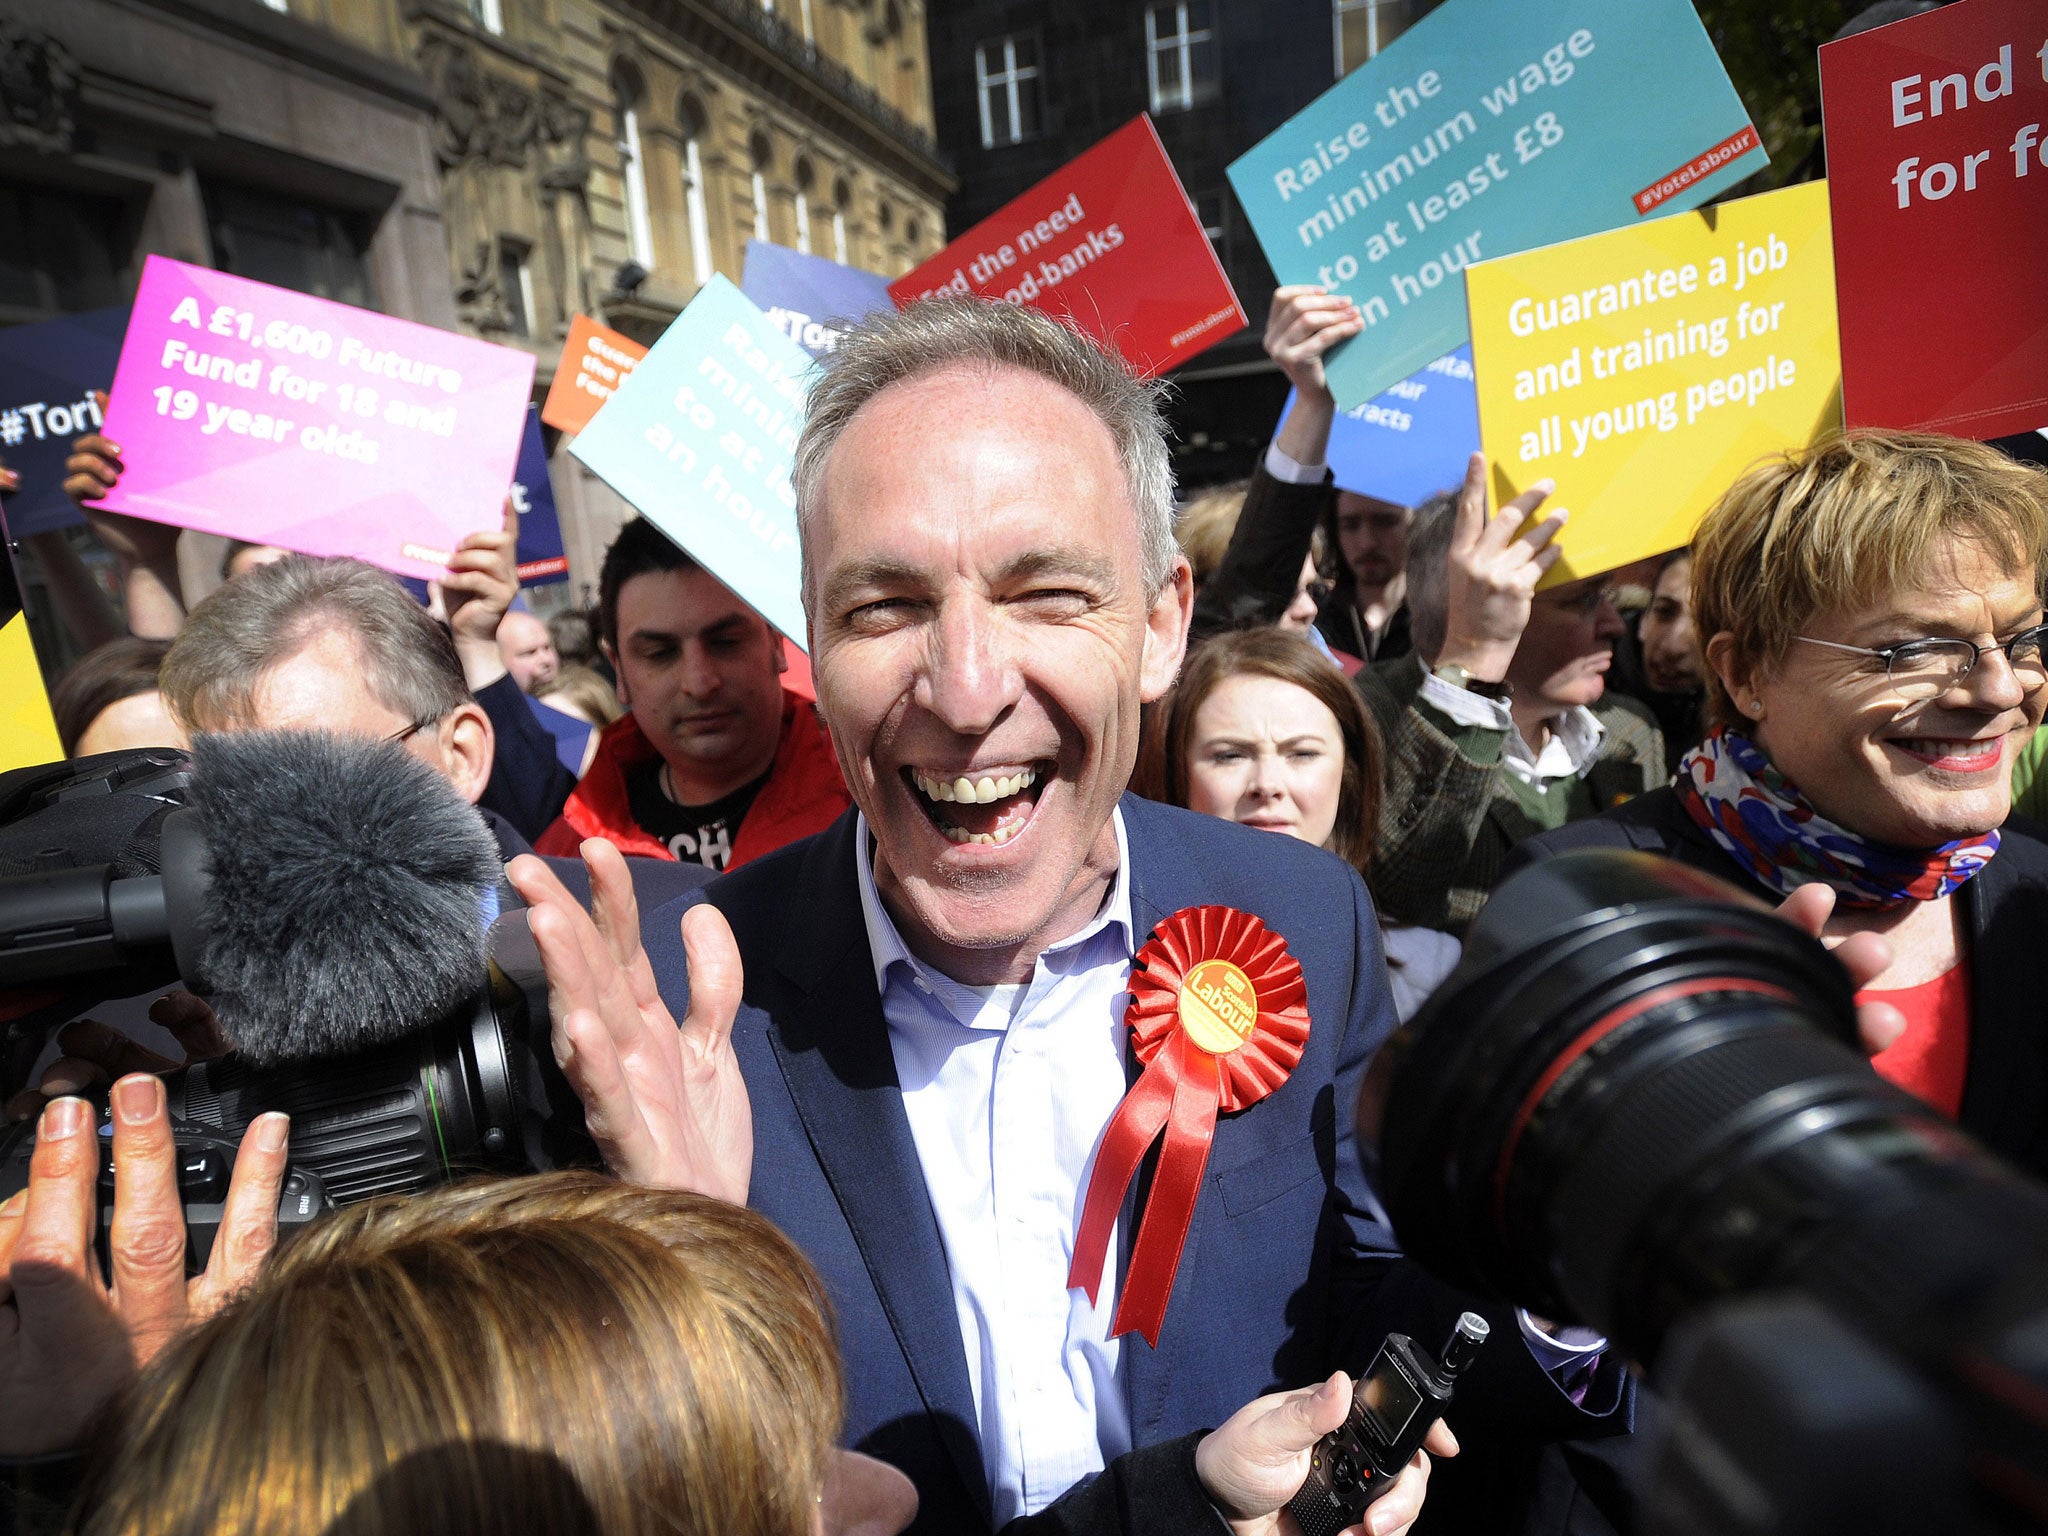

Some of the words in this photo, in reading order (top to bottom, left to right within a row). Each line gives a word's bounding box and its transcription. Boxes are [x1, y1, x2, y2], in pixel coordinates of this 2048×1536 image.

[1891, 45, 2013, 128] End
[1274, 122, 1370, 201] Raise
[1374, 69, 1442, 129] the
[1297, 109, 1478, 247] minimum
[1480, 28, 1596, 117] wage
[1640, 133, 1750, 208] #VoteLabour
[1318, 254, 1359, 291] to
[1365, 220, 1407, 262] at
[1408, 153, 1510, 234] least
[1513, 111, 1566, 165] £8
[1892, 149, 1990, 209] for
[969, 244, 1017, 285] the
[1016, 192, 1086, 255] need
[997, 222, 1125, 306] od-banks
[1361, 295, 1391, 326] n
[1390, 229, 1483, 306] hour
[1509, 264, 1699, 338] Guarantee
[1708, 255, 1728, 287] a
[1734, 233, 1788, 291] job
[170, 297, 200, 329] A
[207, 307, 332, 360] £1,600
[338, 337, 462, 393] Future
[588, 336, 639, 369] Guar
[764, 306, 850, 353] #Tor
[1513, 355, 1583, 402] and
[1591, 316, 1730, 379] training
[1737, 299, 1785, 342] for
[0, 389, 103, 446] #Tori
[154, 386, 199, 421] 19
[202, 402, 295, 443] year
[301, 419, 379, 465] olds
[161, 339, 262, 390] Fund
[269, 364, 326, 405] for
[337, 384, 378, 418] 18
[384, 399, 457, 439] and
[674, 386, 716, 430] to
[719, 431, 763, 474] at
[1519, 415, 1562, 462] all
[1570, 392, 1678, 459] young
[1686, 355, 1796, 425] people
[646, 423, 698, 474] an
[703, 464, 795, 551] hour
[665, 827, 732, 870] CH
[1191, 971, 1251, 1034] Labour
[1222, 985, 1254, 1018] Scottish
[298, 1195, 311, 1215] IRIS
[1391, 1353, 1418, 1387] OLYMPUS
[1358, 1480, 1368, 1493] REC
